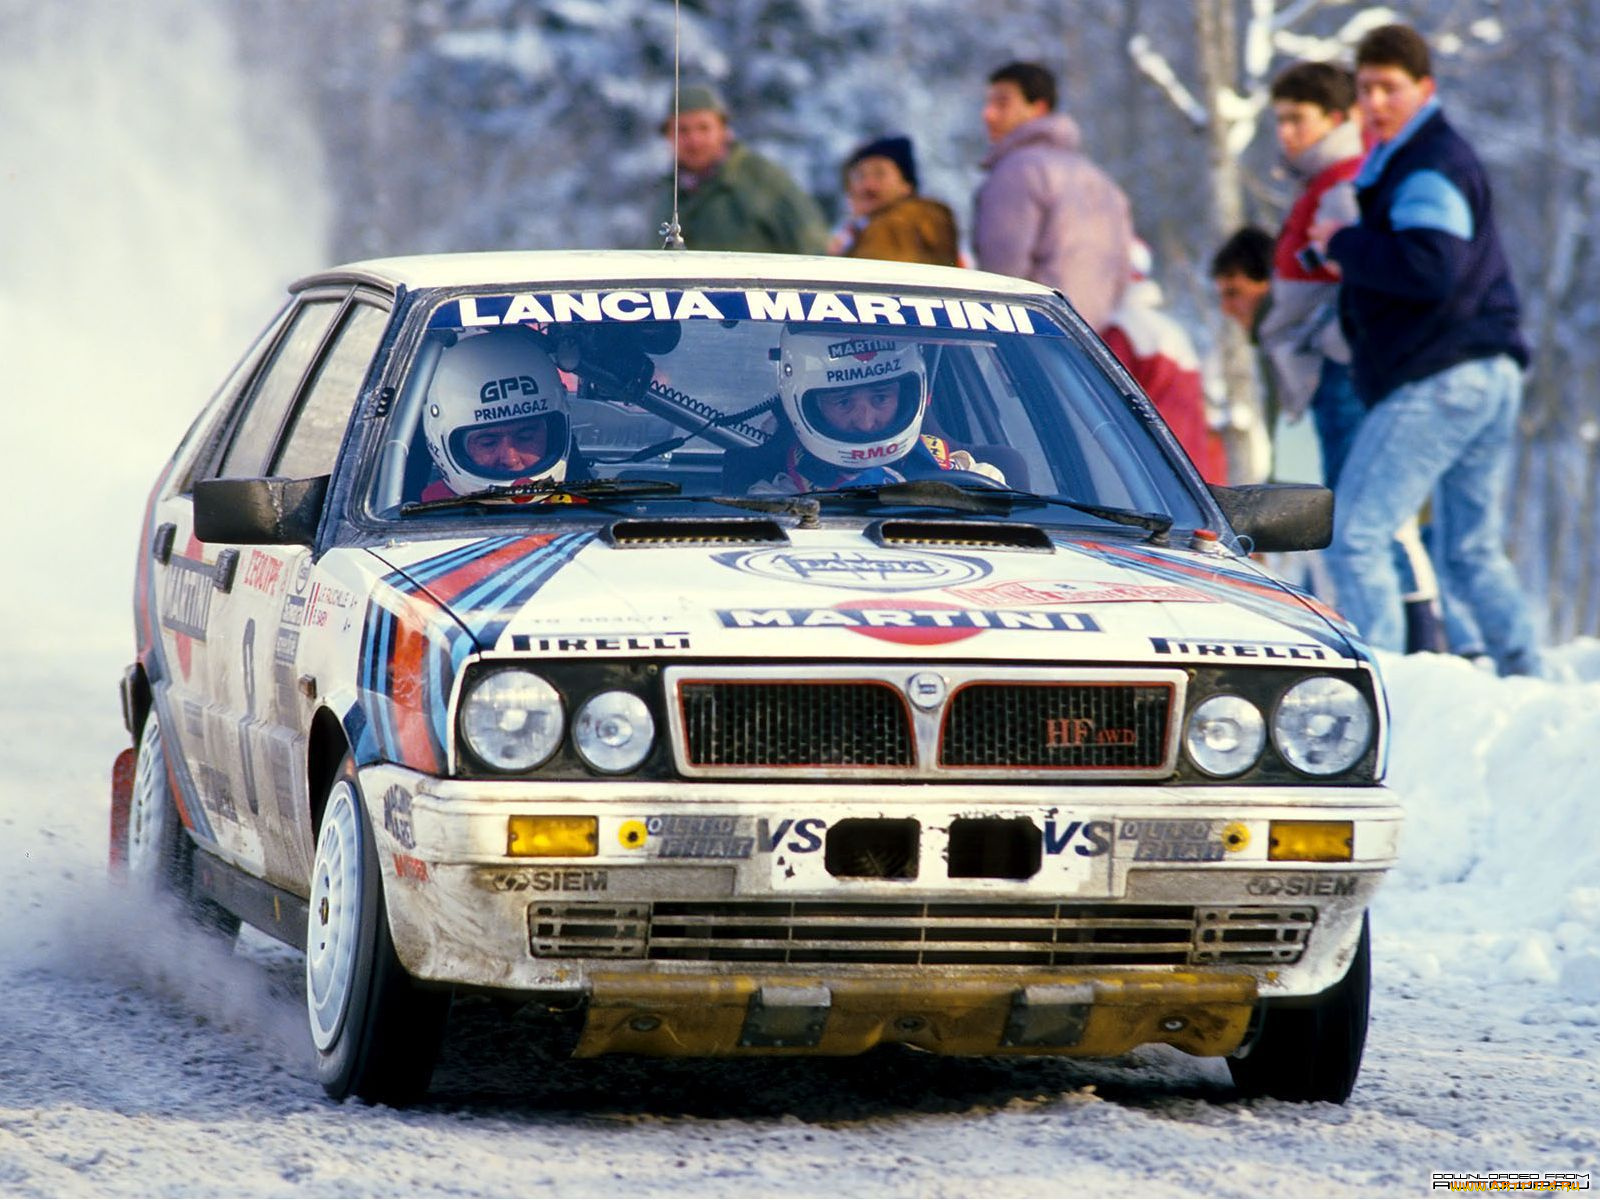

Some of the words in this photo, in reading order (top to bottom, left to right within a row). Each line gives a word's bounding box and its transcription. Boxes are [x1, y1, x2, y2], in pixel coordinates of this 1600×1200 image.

[459, 291, 725, 327] LANCIA
[745, 291, 1035, 334] MARTINI
[830, 340, 894, 358] MARTINI
[826, 358, 902, 382] PRIMAGAZ
[480, 375, 539, 404] GPA
[474, 398, 549, 422] PRIMAGAZ
[730, 608, 1090, 630] MARTINI
[512, 632, 690, 652] PIRELLI
[1149, 637, 1326, 661] PIRELLI
[1045, 717, 1095, 747] HF
[757, 818, 826, 853] VS
[1044, 821, 1114, 857] VS
[532, 871, 608, 892] SIEM
[1285, 876, 1358, 897] SIEM
